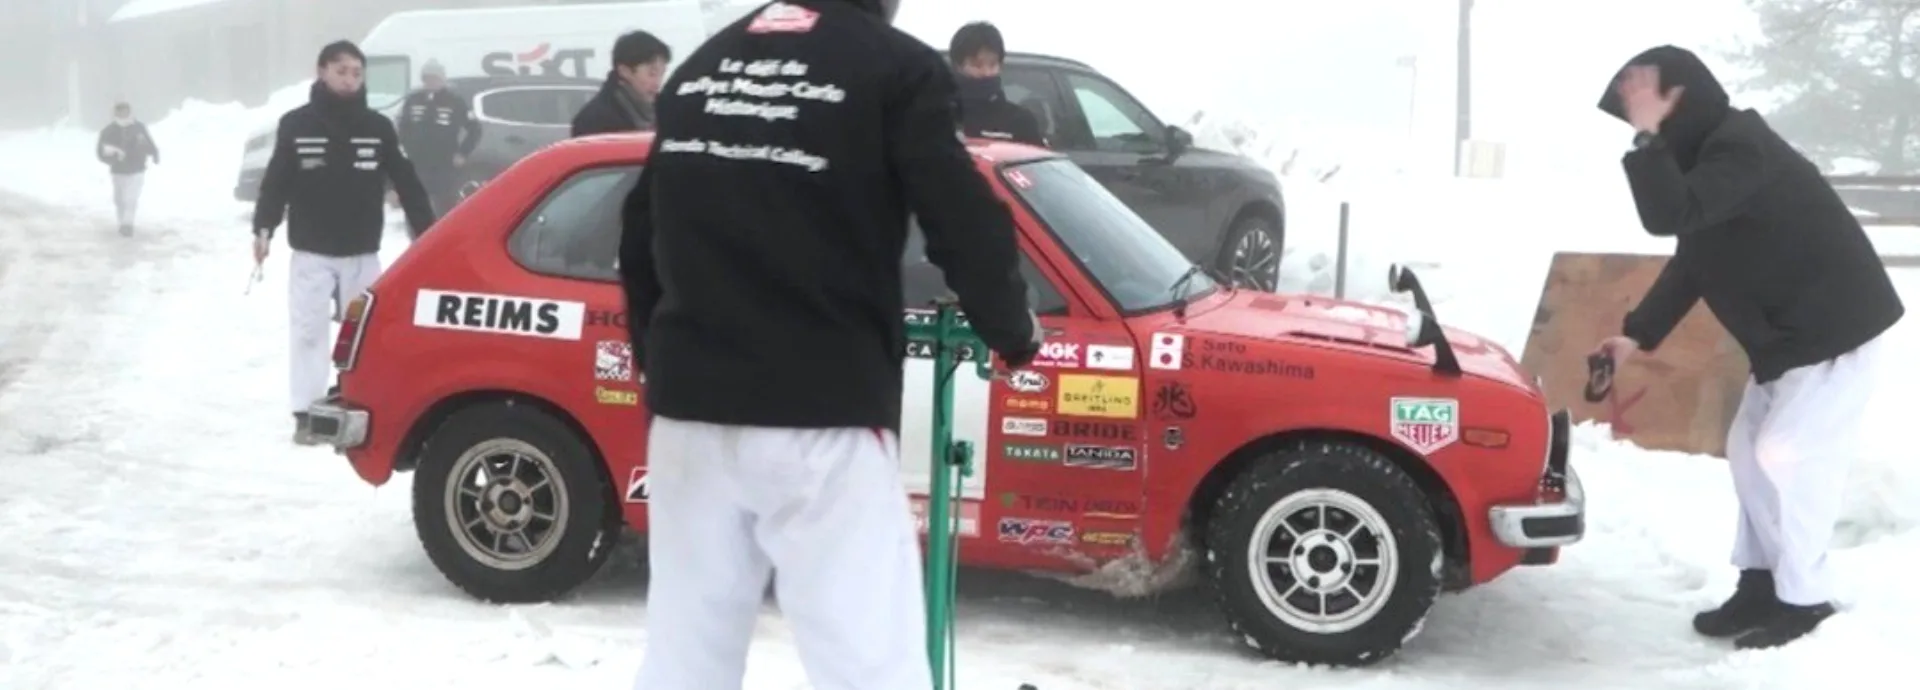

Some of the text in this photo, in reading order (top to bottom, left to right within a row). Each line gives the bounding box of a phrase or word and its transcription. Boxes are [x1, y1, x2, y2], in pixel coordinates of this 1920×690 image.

[780, 60, 808, 76] du
[436, 295, 560, 334] REIMS
[1063, 391, 1133, 407] BREITLING
[1400, 405, 1450, 421] TAG
[1005, 446, 1060, 460] TAKATA
